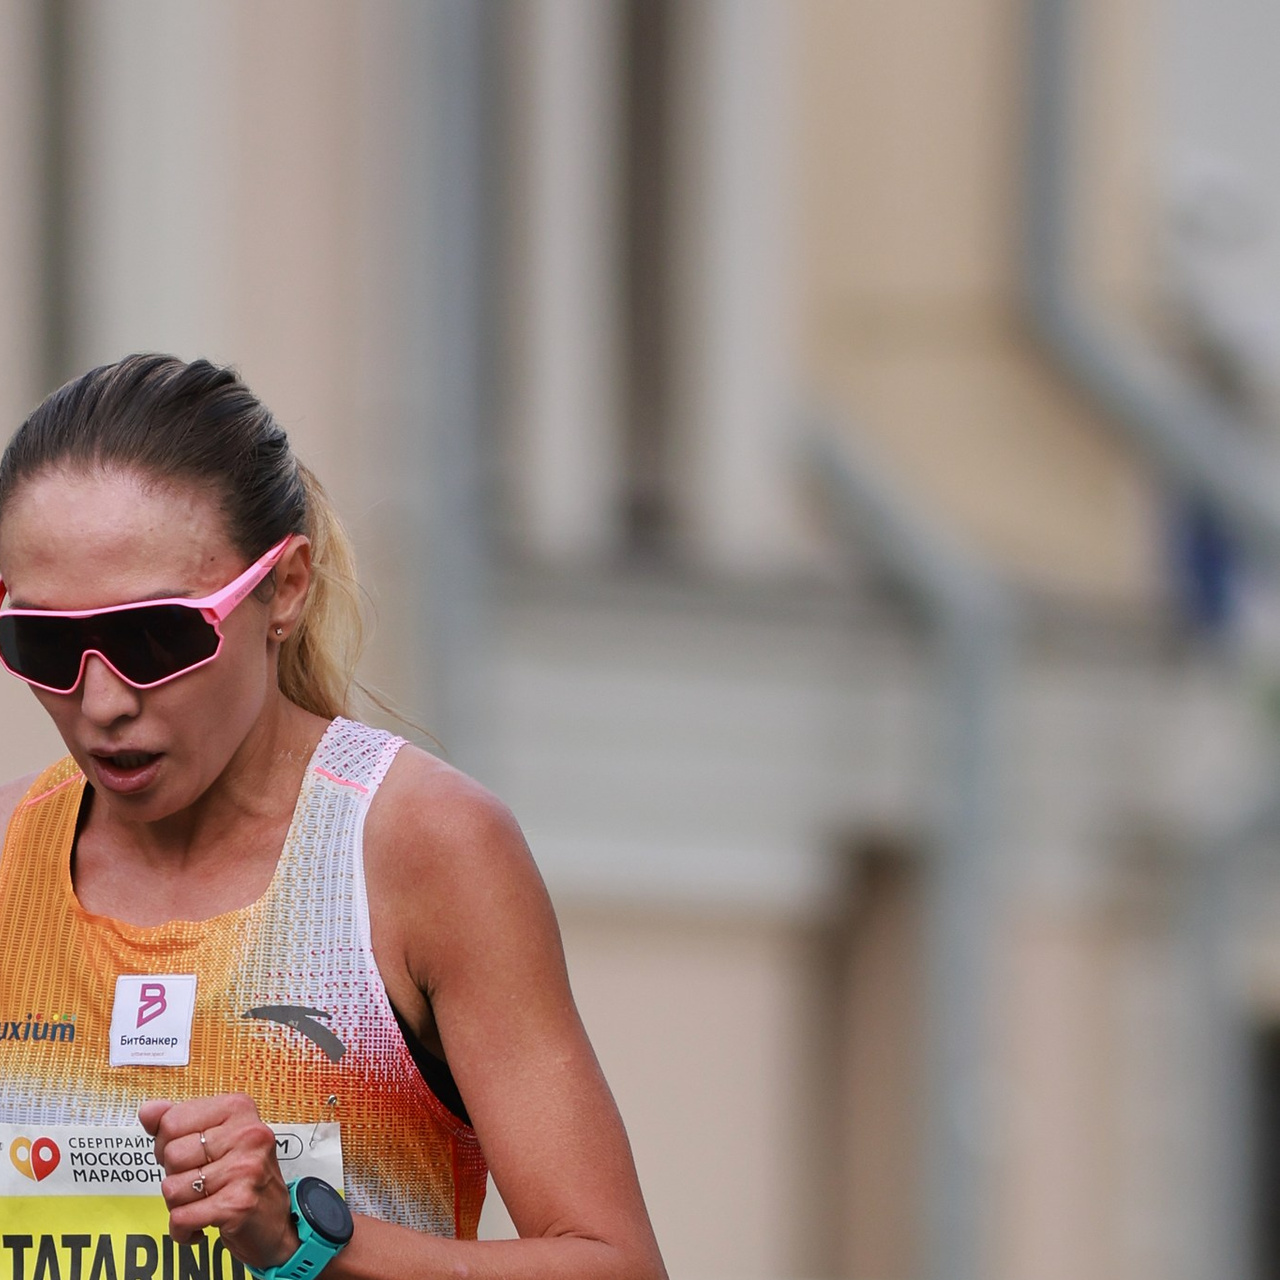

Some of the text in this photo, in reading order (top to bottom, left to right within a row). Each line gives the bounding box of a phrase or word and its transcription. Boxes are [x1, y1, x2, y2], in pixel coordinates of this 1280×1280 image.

[120, 1035, 178, 1048] Битбанкер
[70, 1152, 160, 1166] МОСКОВС
[73, 1169, 162, 1183] МАРАФОН
